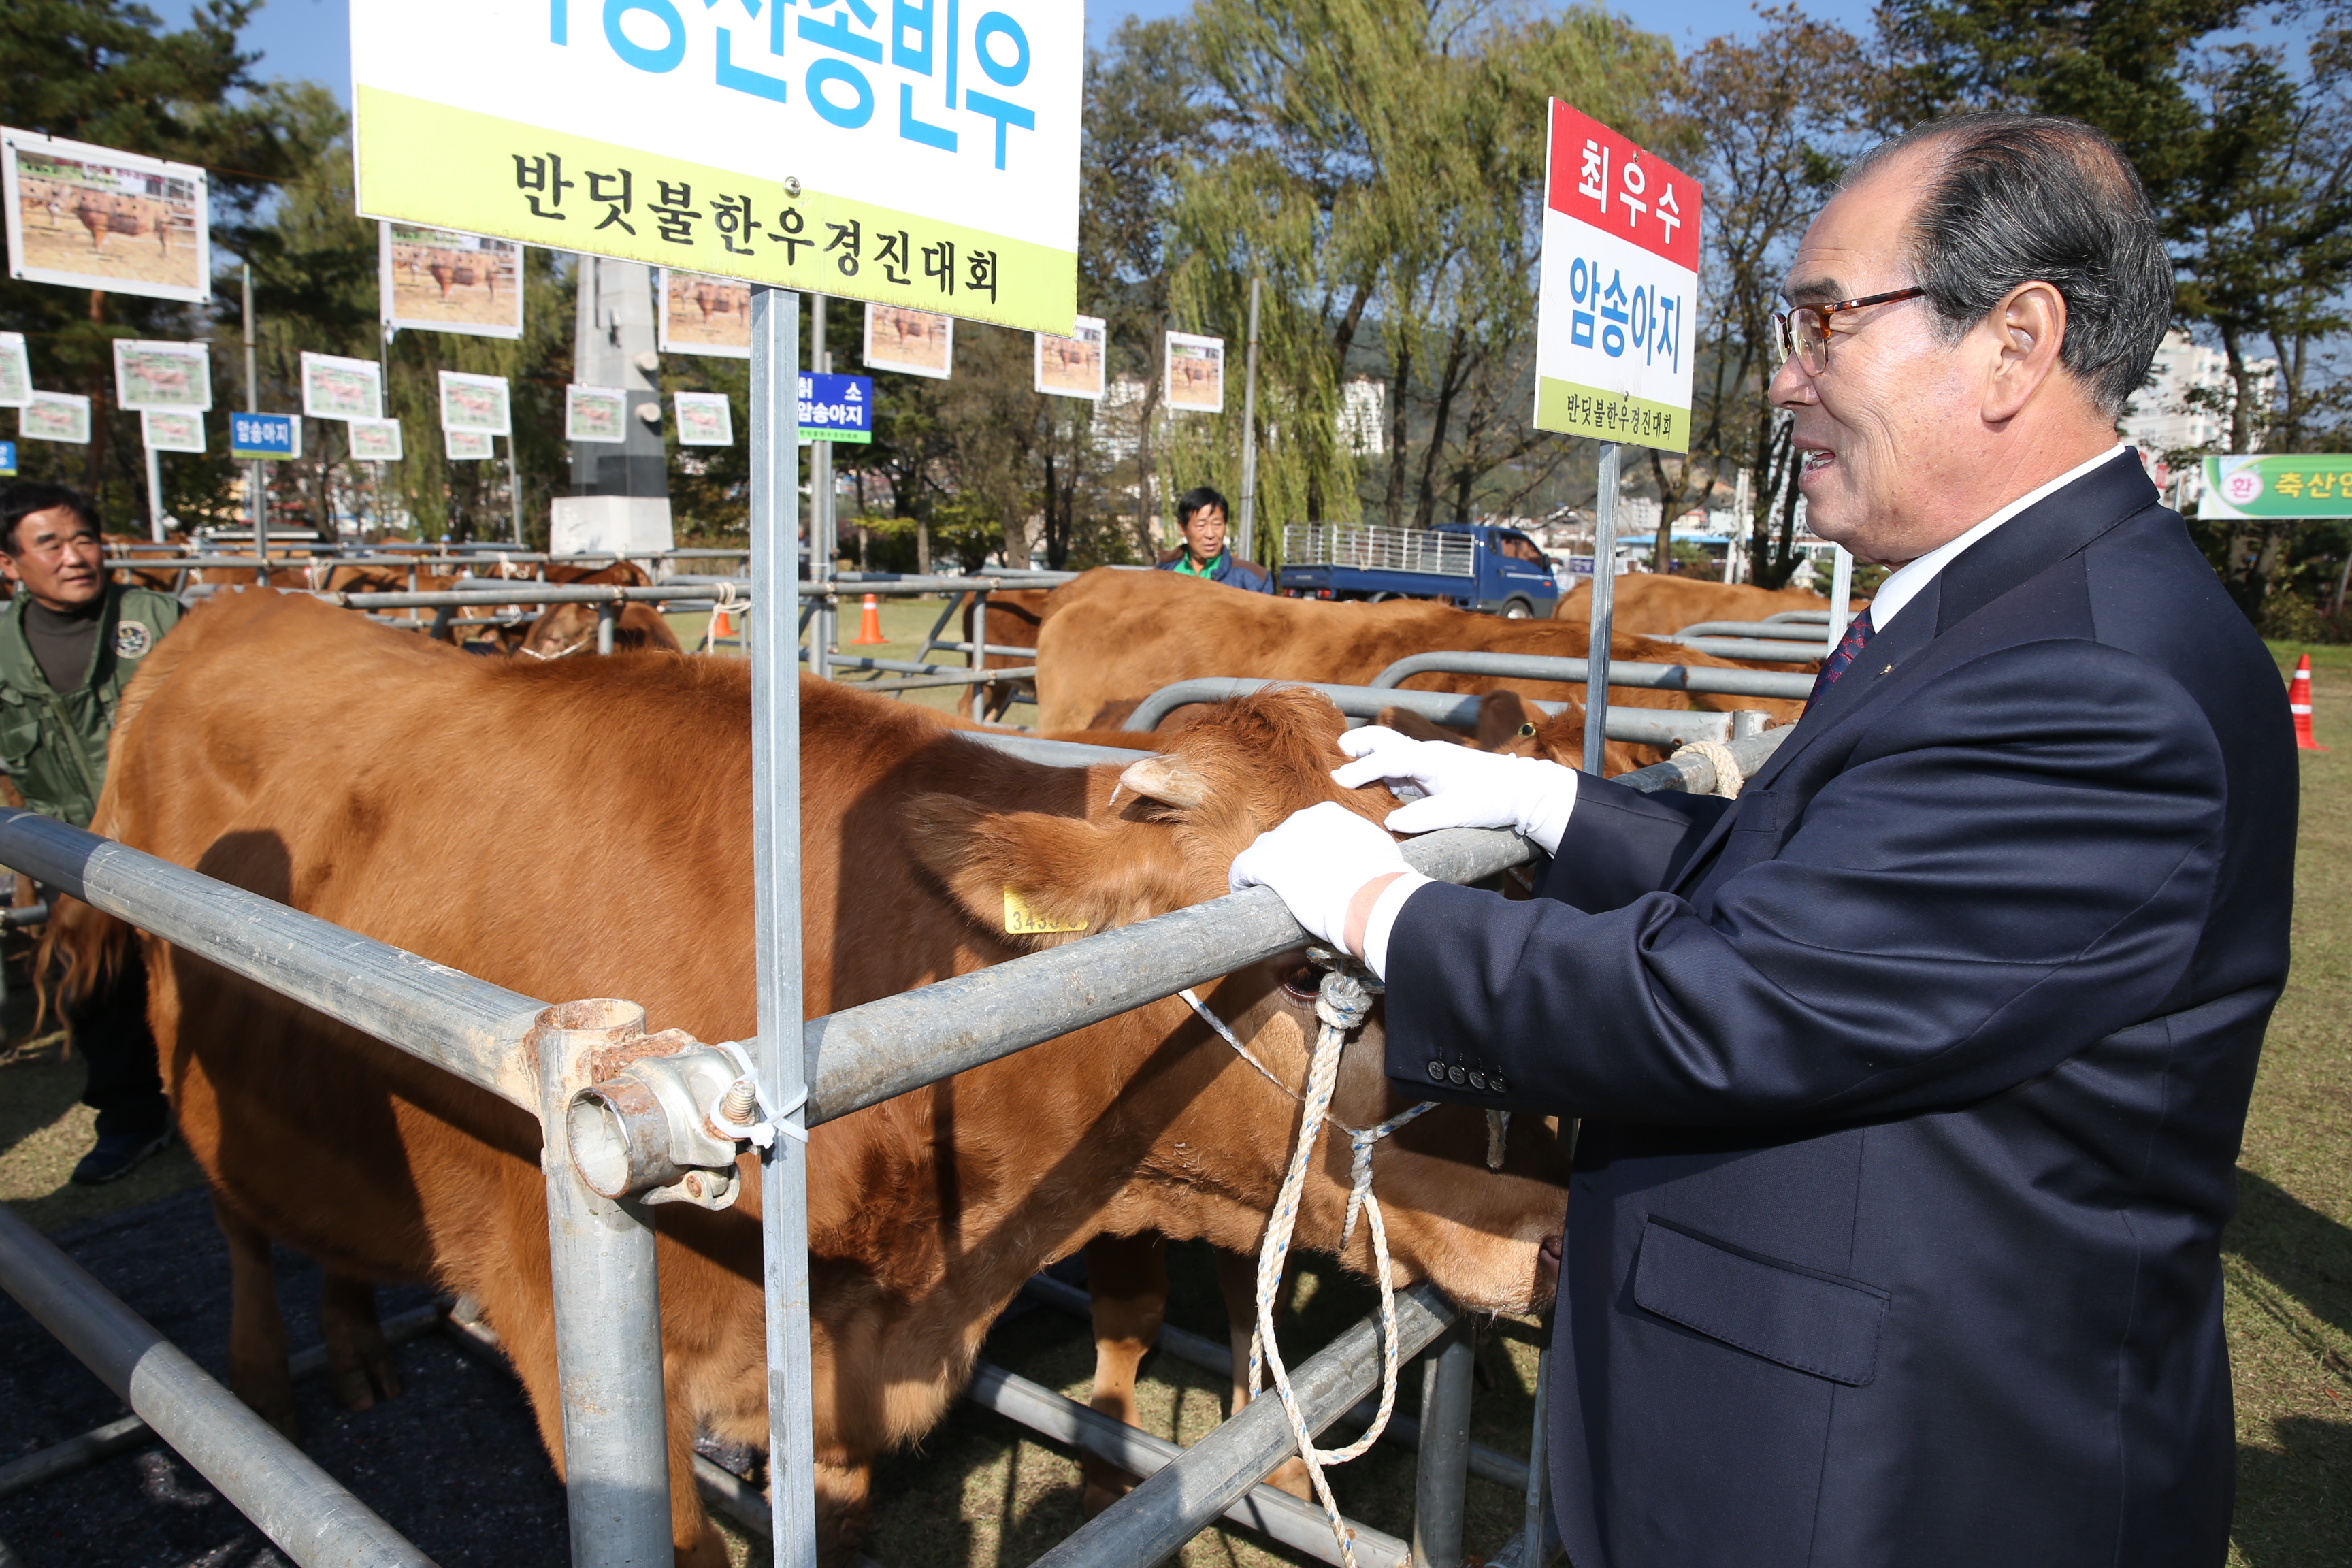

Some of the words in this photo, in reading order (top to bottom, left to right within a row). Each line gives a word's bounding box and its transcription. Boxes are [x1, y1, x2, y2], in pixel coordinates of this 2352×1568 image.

[1578, 138, 1680, 245] 최우수
[512, 152, 997, 305] 반딧불한우경진대회
[1570, 257, 1681, 374] 암송아지
[235, 419, 289, 446] 암송아지
[798, 401, 863, 427] 암송아지
[1567, 393, 1671, 440] 반딧불한우경진대회
[2230, 477, 2253, 498] 환
